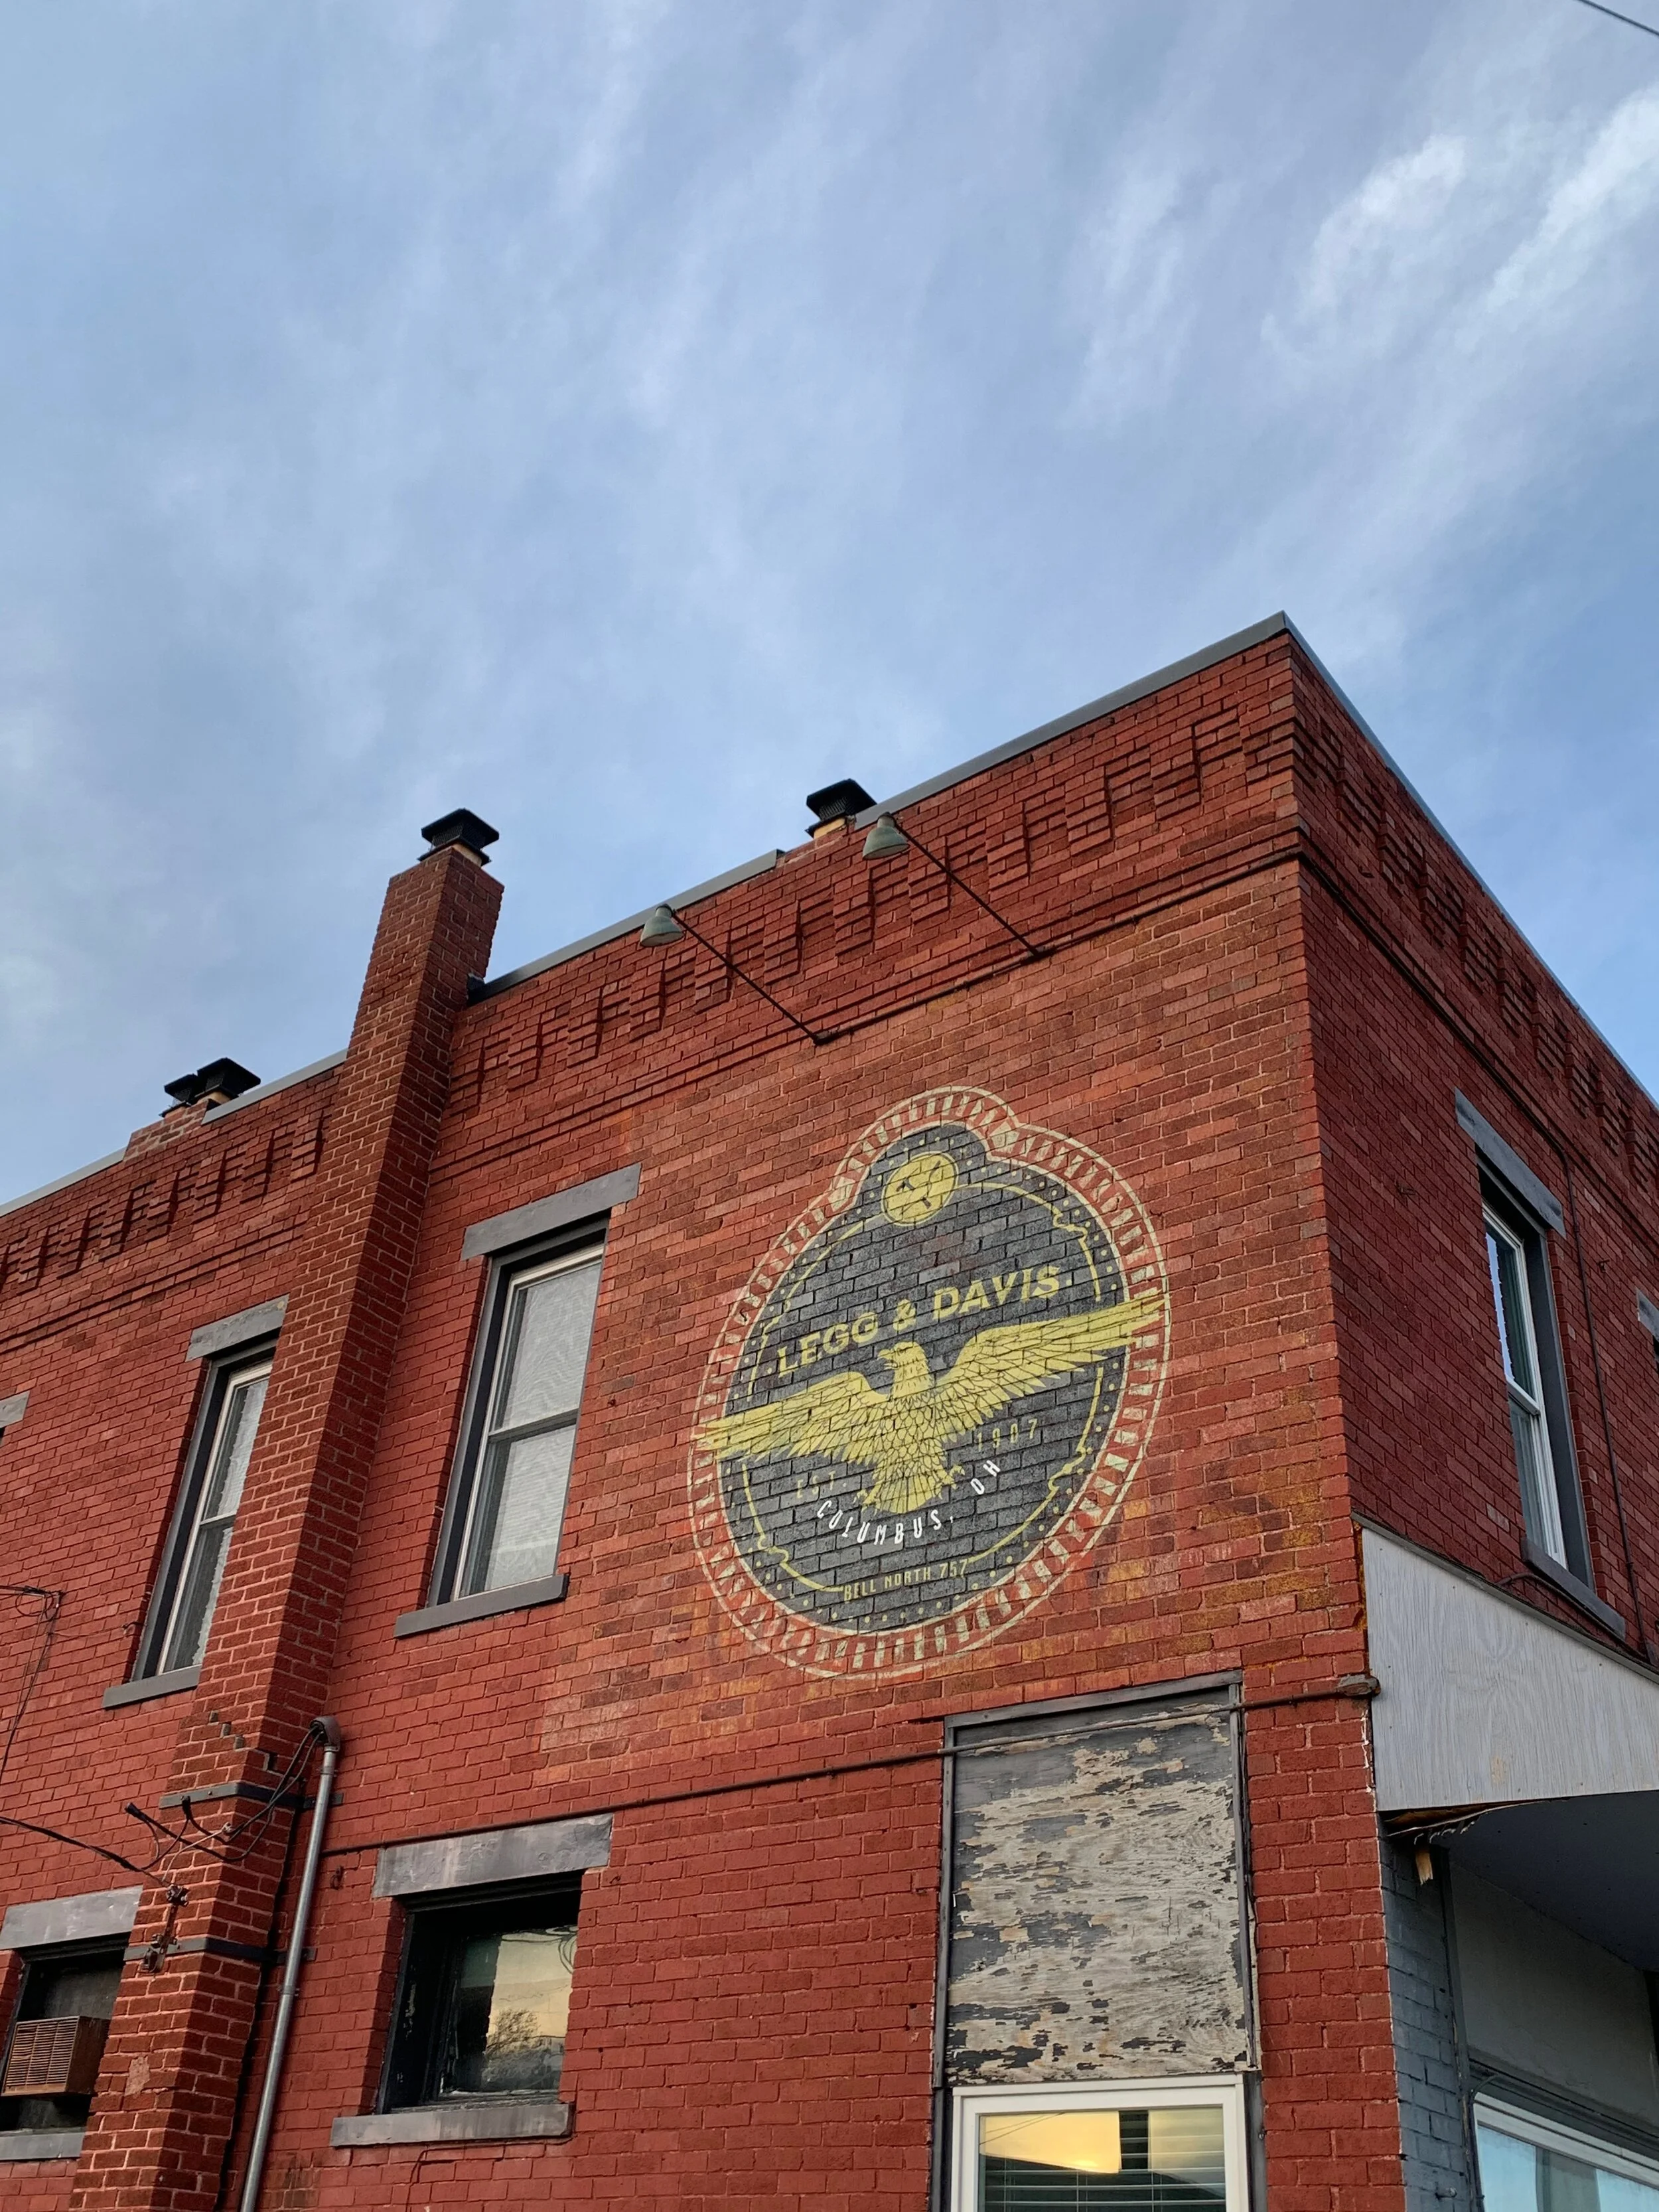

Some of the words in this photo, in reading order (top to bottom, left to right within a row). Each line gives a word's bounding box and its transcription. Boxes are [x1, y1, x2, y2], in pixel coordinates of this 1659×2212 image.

[777, 1312, 879, 1378] LEGG
[893, 1299, 917, 1332] &
[932, 1266, 1060, 1320] DAVIS
[976, 1419, 1038, 1451] 1907
[816, 1500, 954, 1546] COLUMBUS,
[970, 1459, 1001, 1495] OH
[843, 1578, 877, 1603] BELL
[884, 1566, 932, 1588] NORTH
[940, 1559, 969, 1580] 757
